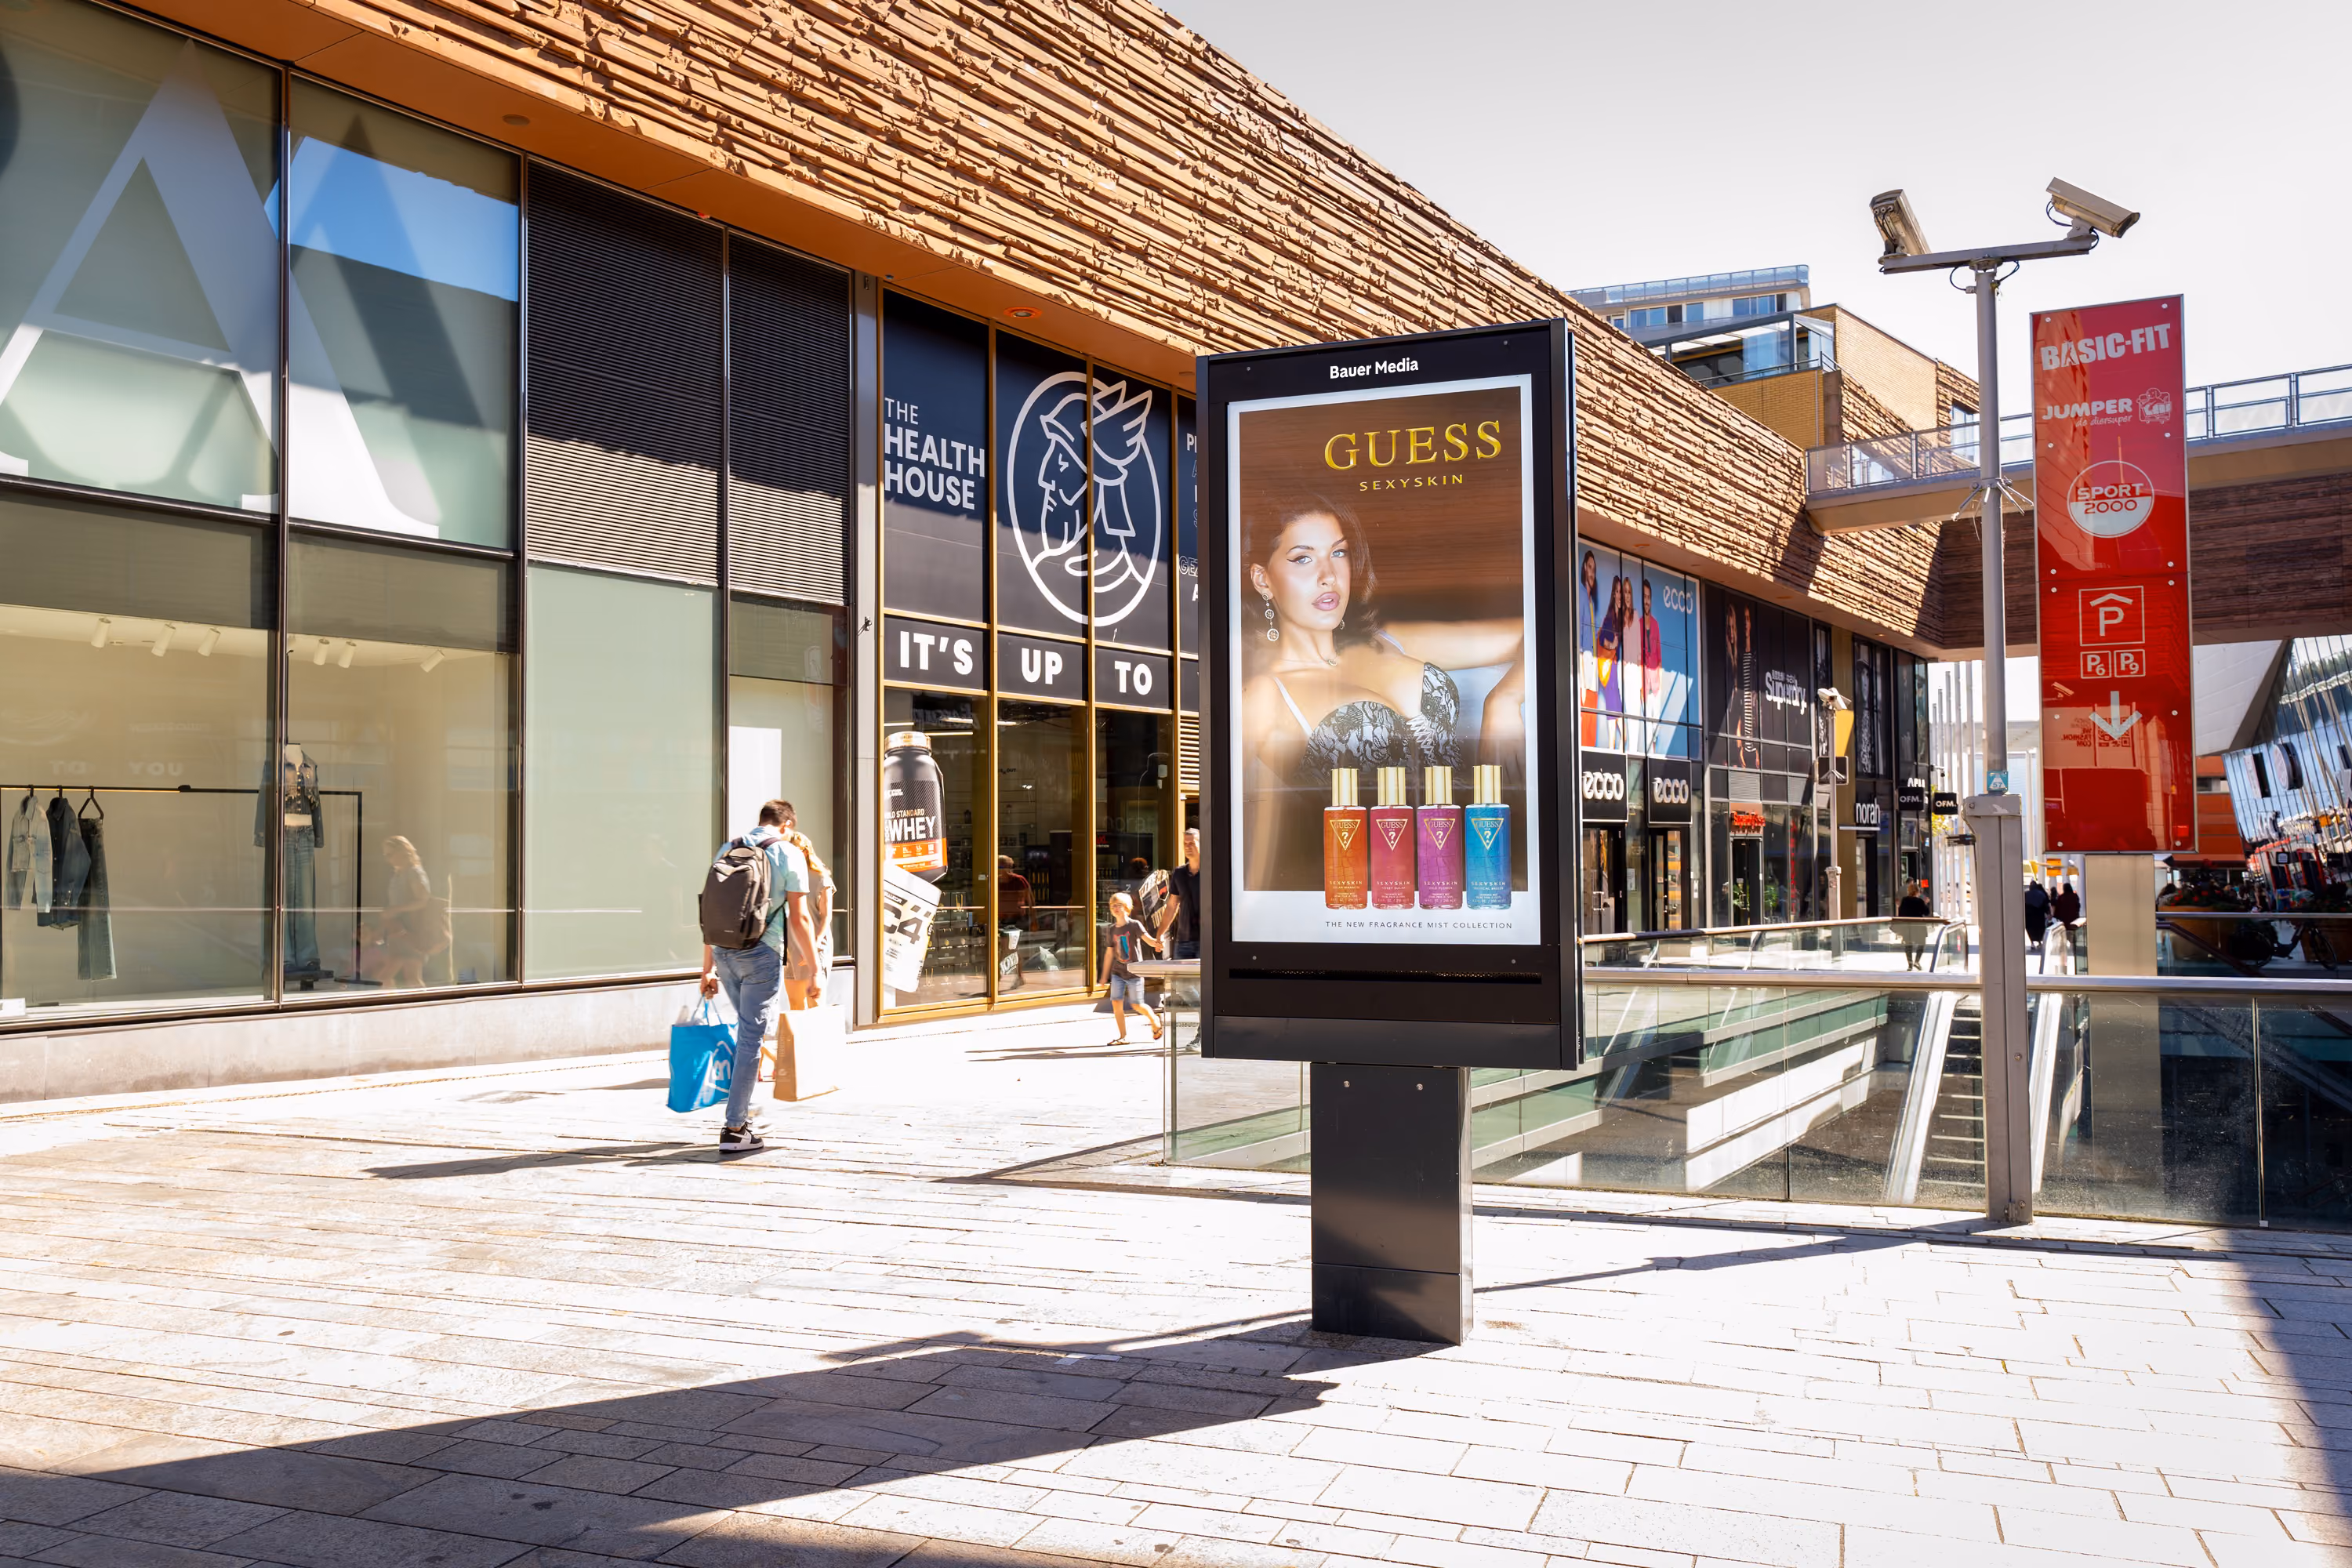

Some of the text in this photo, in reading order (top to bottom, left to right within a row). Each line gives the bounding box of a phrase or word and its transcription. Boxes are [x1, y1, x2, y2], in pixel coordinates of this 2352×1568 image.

[2040, 323, 2171, 371] BASIC-FIT
[1330, 358, 1419, 379] Bauer Media
[884, 397, 919, 425] THE
[2042, 397, 2133, 420] JUMPER
[2075, 414, 2133, 427] de diersuper
[884, 423, 985, 477] HEALTH
[1324, 419, 1501, 471] GUESS
[884, 459, 975, 510] HOUSE
[1359, 474, 1463, 492] SEXYSKIN
[2078, 483, 2144, 501] SPORT
[2084, 499, 2138, 515] 2000
[1663, 585, 1693, 615] ecco
[2099, 606, 2125, 637] P
[900, 630, 1152, 696] IT'S UP TO
[2086, 652, 2140, 676] P6 P9
[1582, 771, 1624, 800] ecco
[1652, 777, 1690, 804] ecco
[896, 808, 925, 818] STANDARD
[1856, 798, 1881, 825] norah
[890, 816, 936, 841] WHEY
[884, 902, 924, 945] C4
